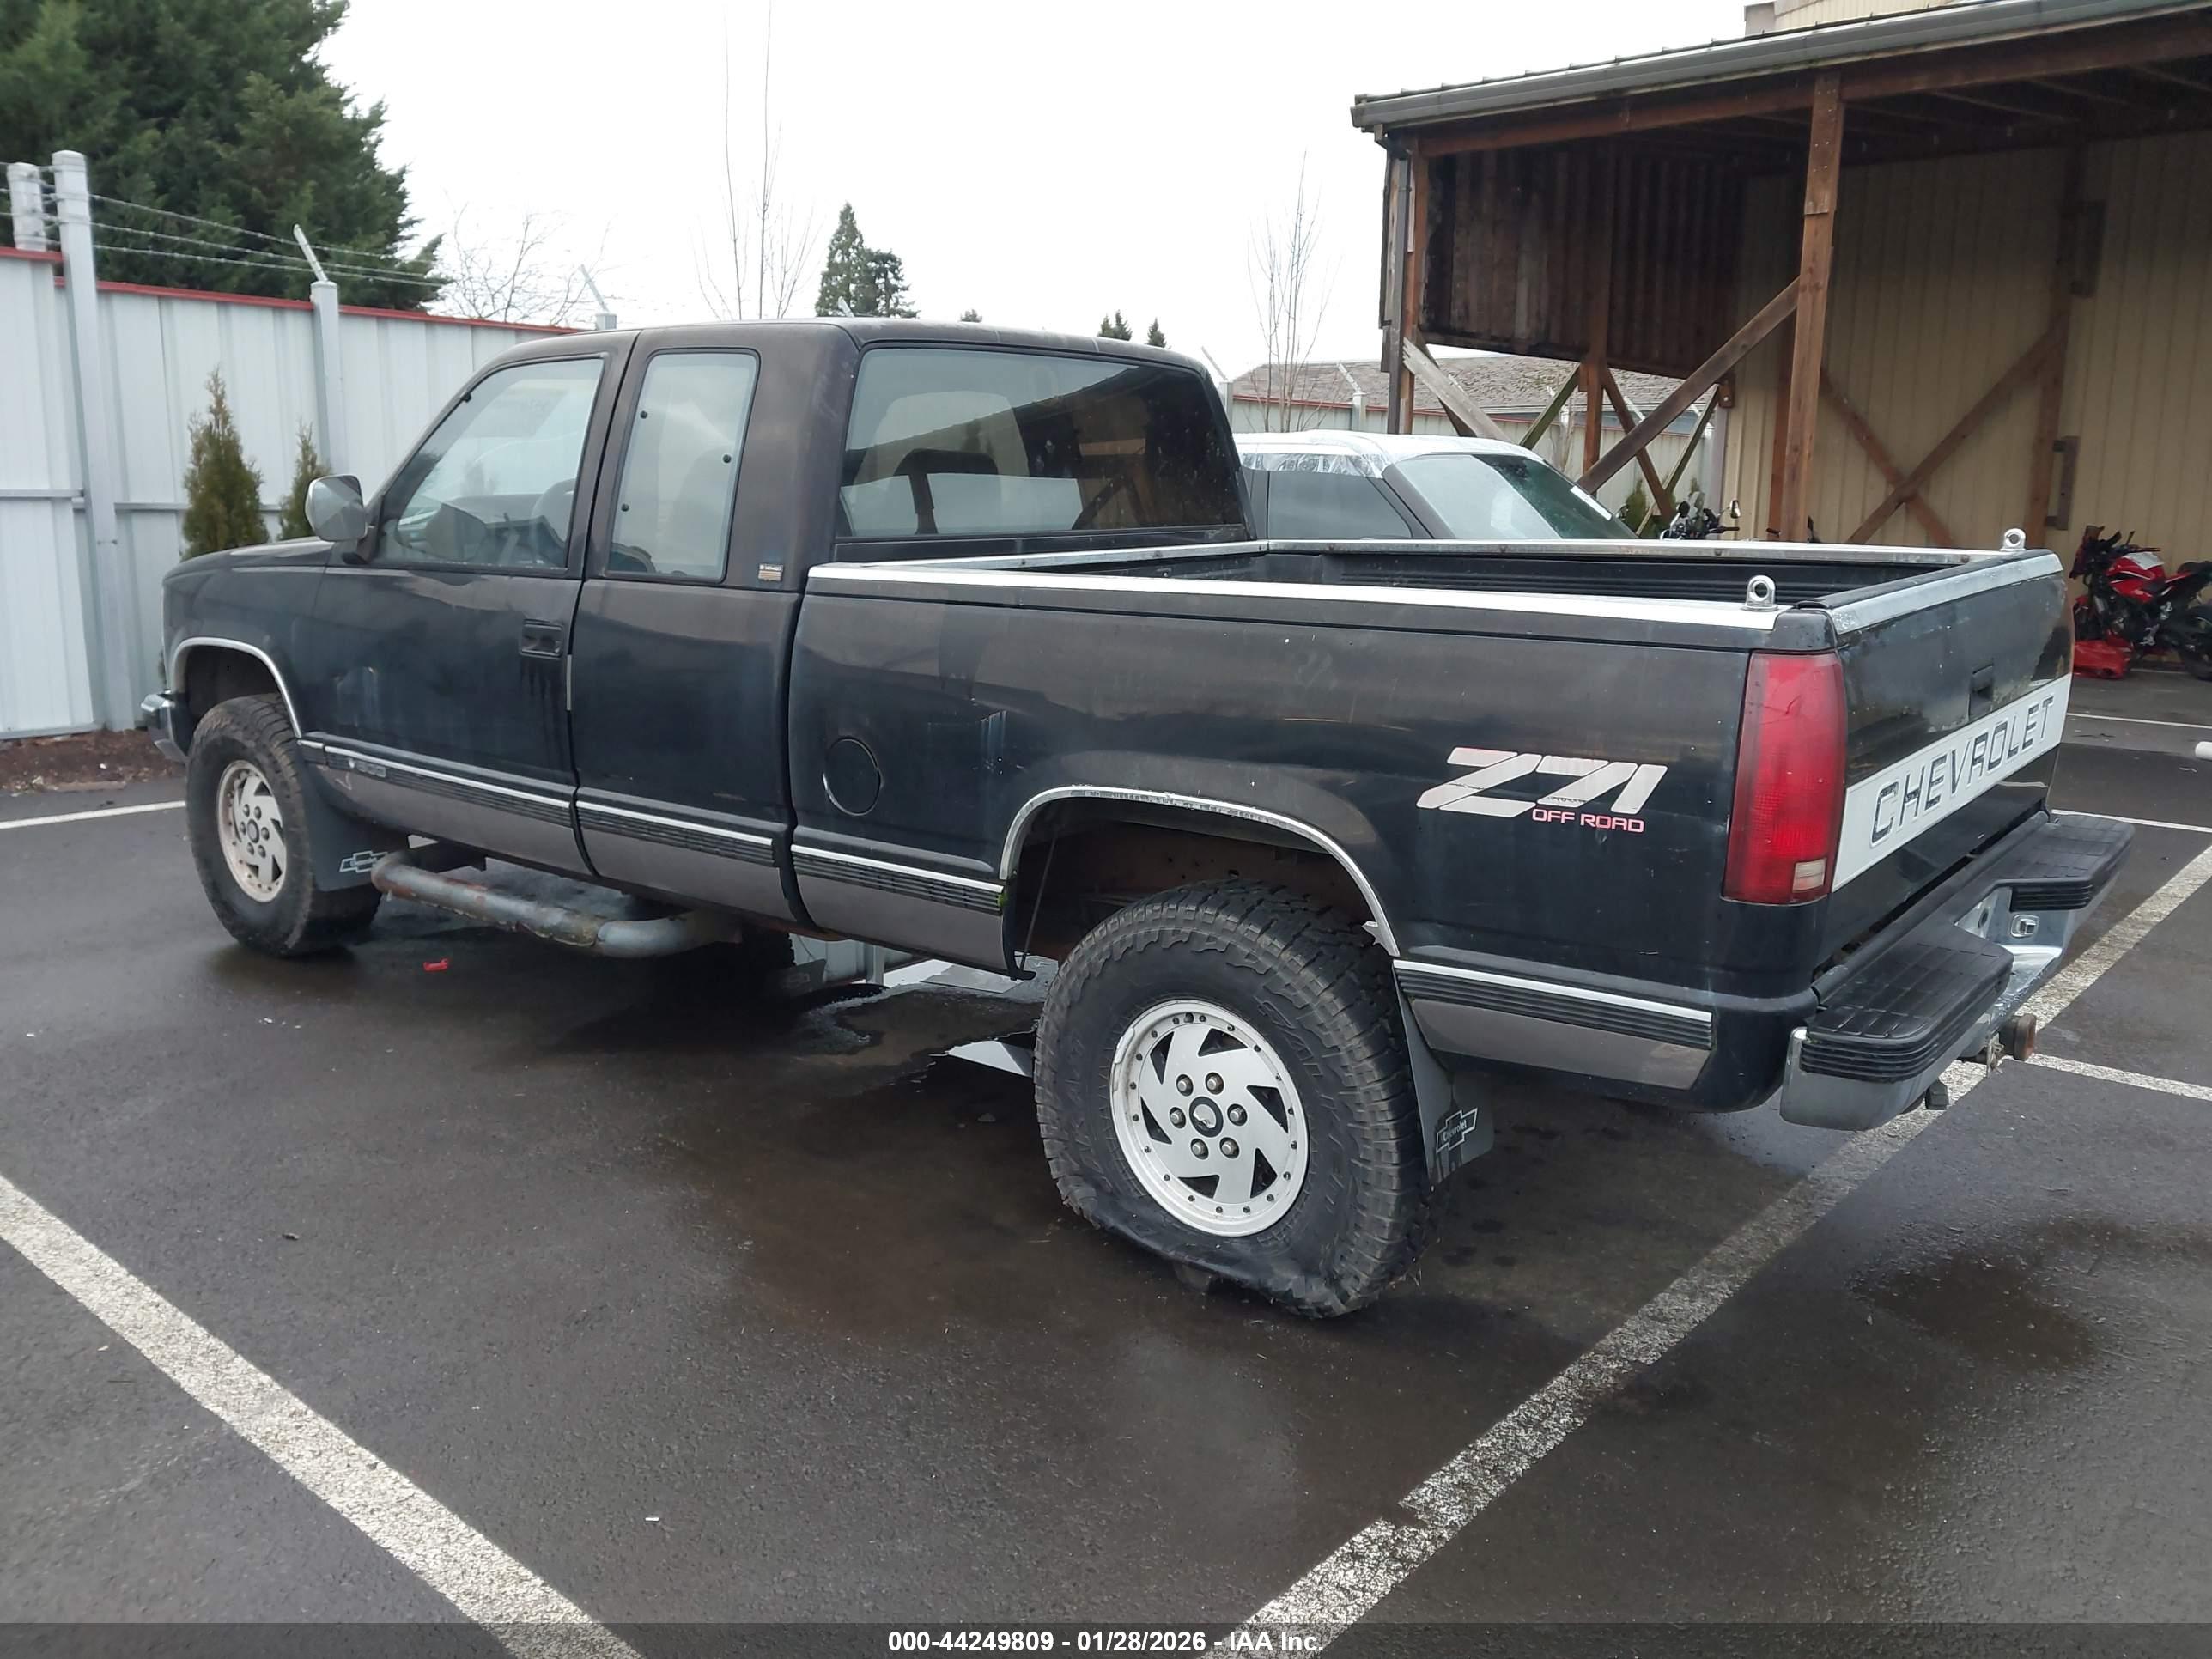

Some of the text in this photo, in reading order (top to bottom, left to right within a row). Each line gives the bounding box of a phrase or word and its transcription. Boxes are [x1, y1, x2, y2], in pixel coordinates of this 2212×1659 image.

[1417, 746, 1668, 817] Z71
[1869, 696, 2054, 848] CHEVROLET
[1532, 808, 1644, 833] OFF ROAD
